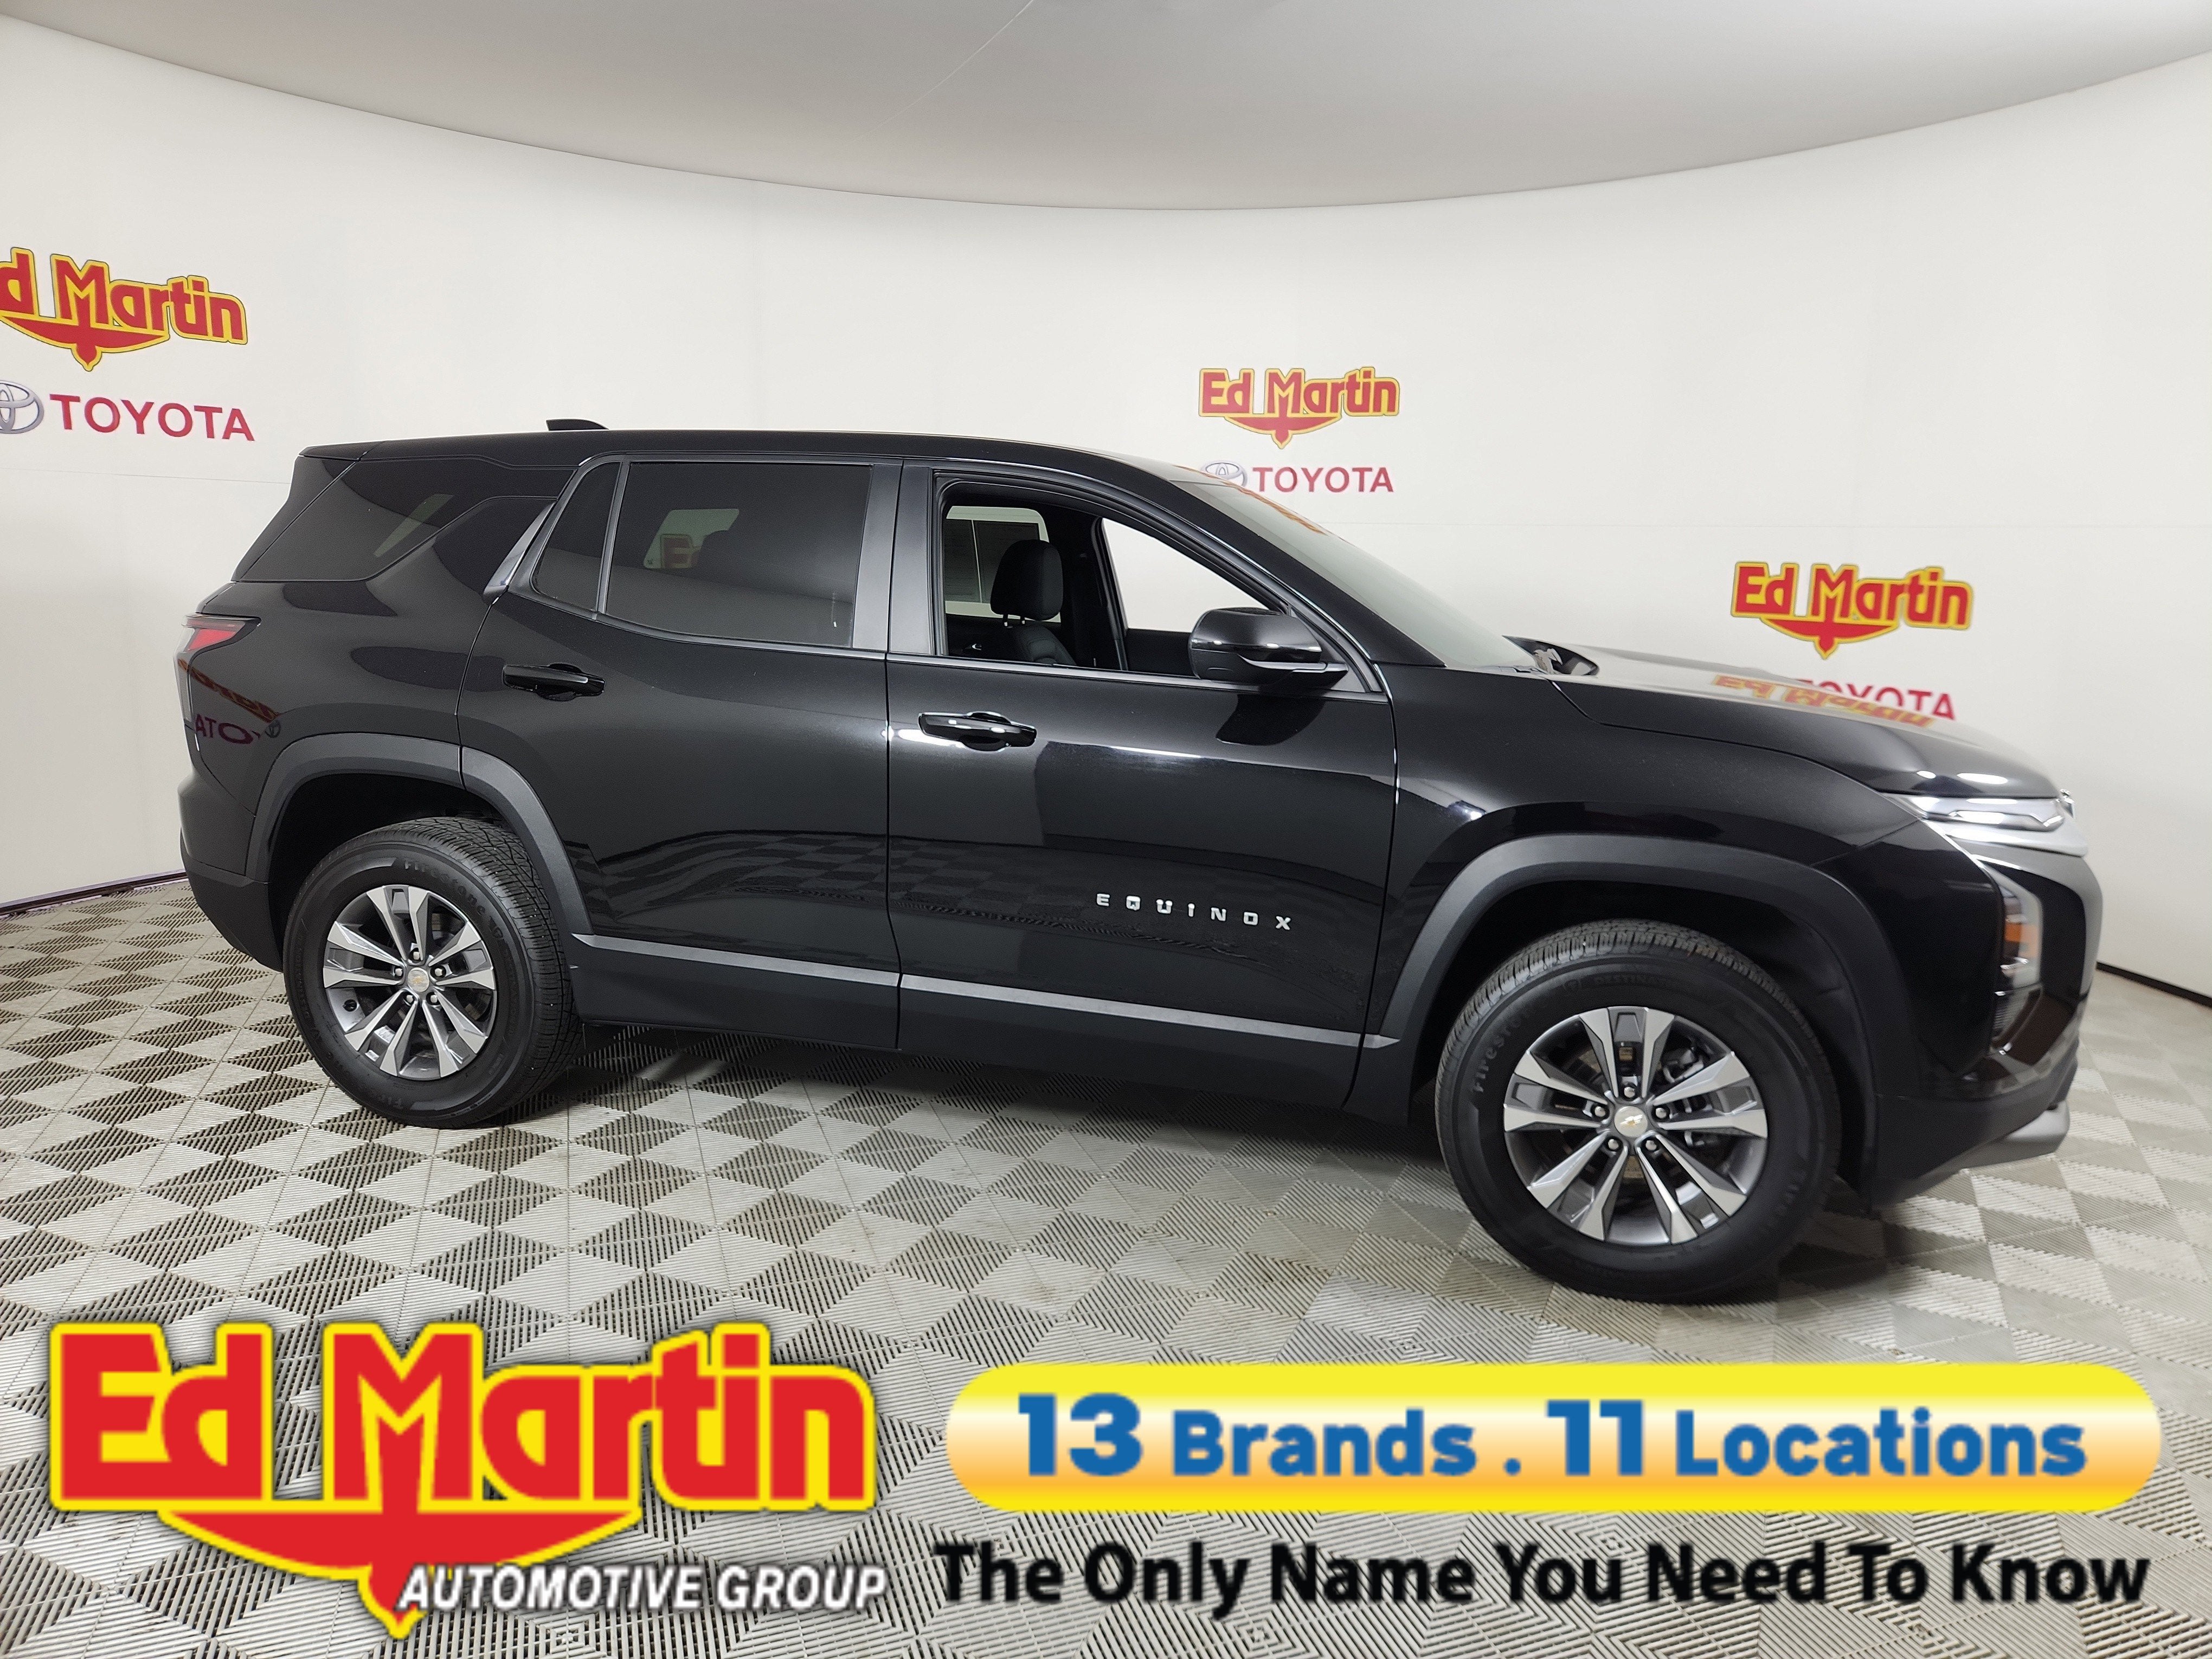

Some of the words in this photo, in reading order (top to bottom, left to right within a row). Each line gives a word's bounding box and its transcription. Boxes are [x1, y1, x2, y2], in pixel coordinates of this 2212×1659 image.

[0, 247, 39, 317] d
[51, 254, 248, 344] Martin
[1199, 369, 1253, 416] Ed
[1265, 367, 1400, 416] Martin
[49, 394, 255, 441] TOYOTA
[1252, 467, 1394, 493] TOYOTA
[1732, 562, 1799, 619] Ed
[1809, 564, 1972, 630] Martin
[1796, 678, 1956, 721] YOTA
[1096, 893, 1291, 930] EQUINOX
